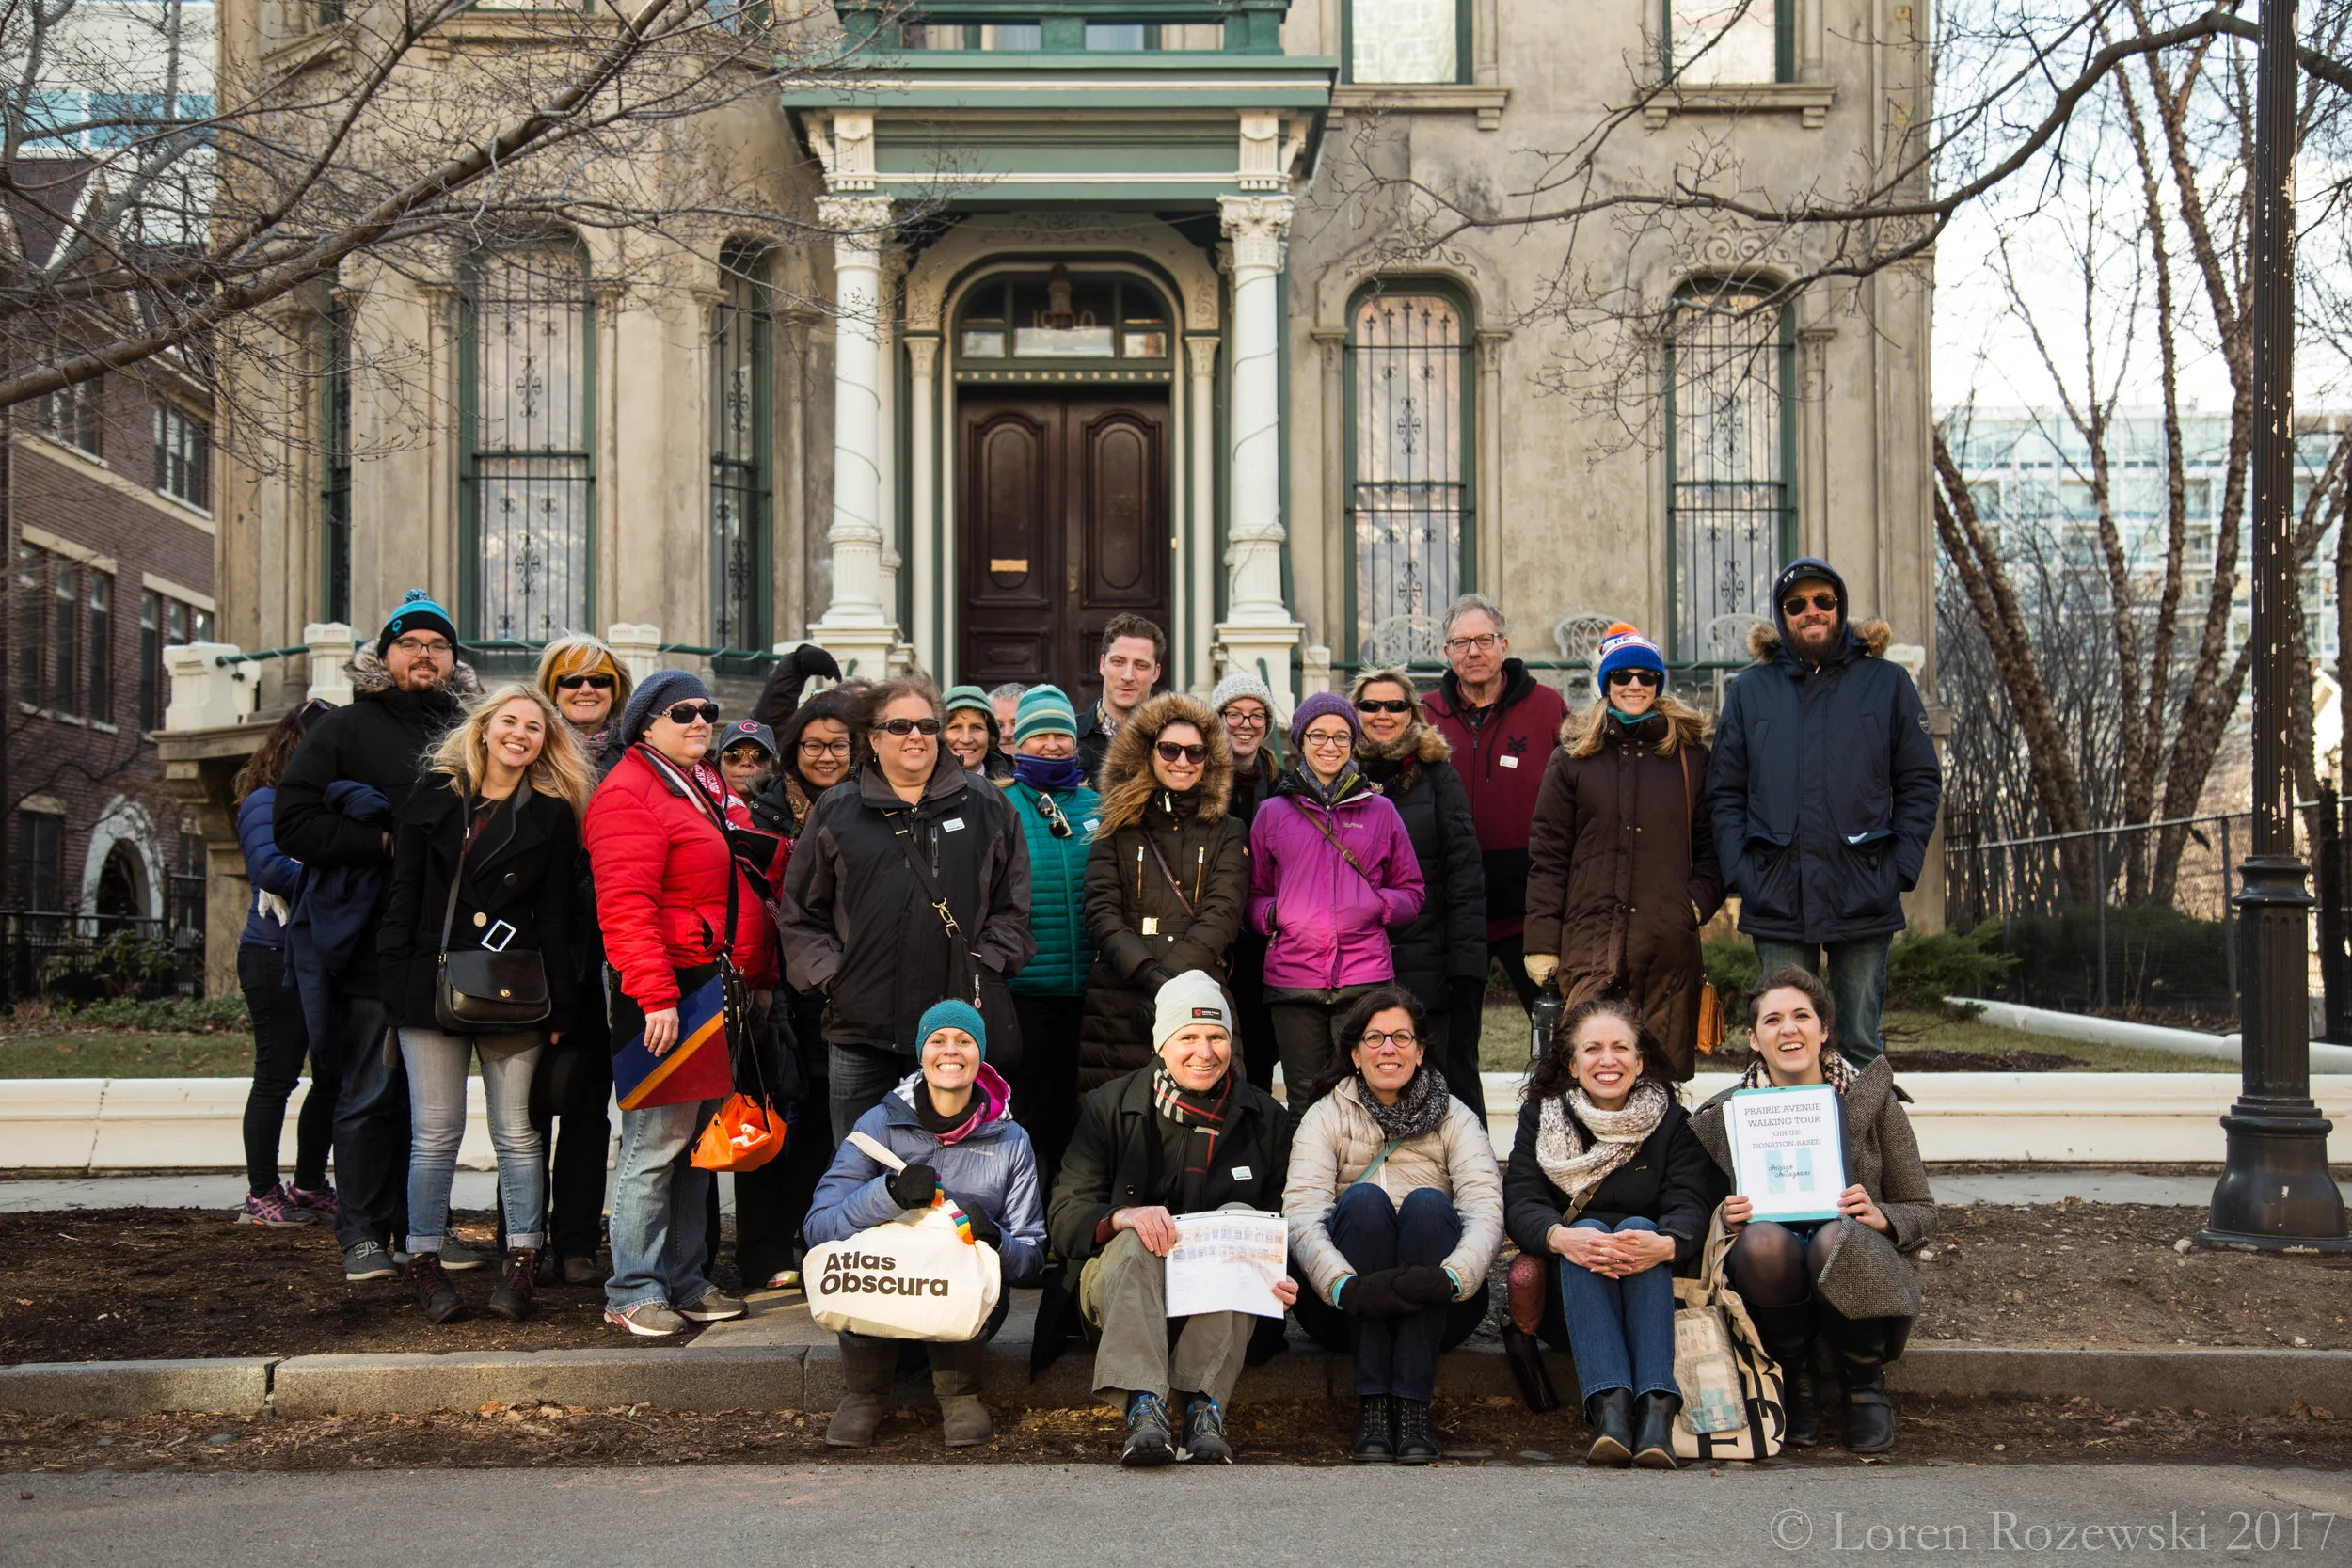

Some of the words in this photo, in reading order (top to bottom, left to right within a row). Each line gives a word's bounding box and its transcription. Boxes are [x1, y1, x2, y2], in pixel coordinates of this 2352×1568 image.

[739, 720, 758, 733] C
[1744, 1105, 1781, 1116] PRAIRIE
[1782, 1102, 1821, 1113] AVENUE
[1747, 1117, 1792, 1127] WALKING
[1794, 1116, 1821, 1124] TOUR
[1753, 1139, 1821, 1149] DONATION-BASED
[823, 1251, 897, 1275] Atlas
[820, 1272, 949, 1297] Obscura
